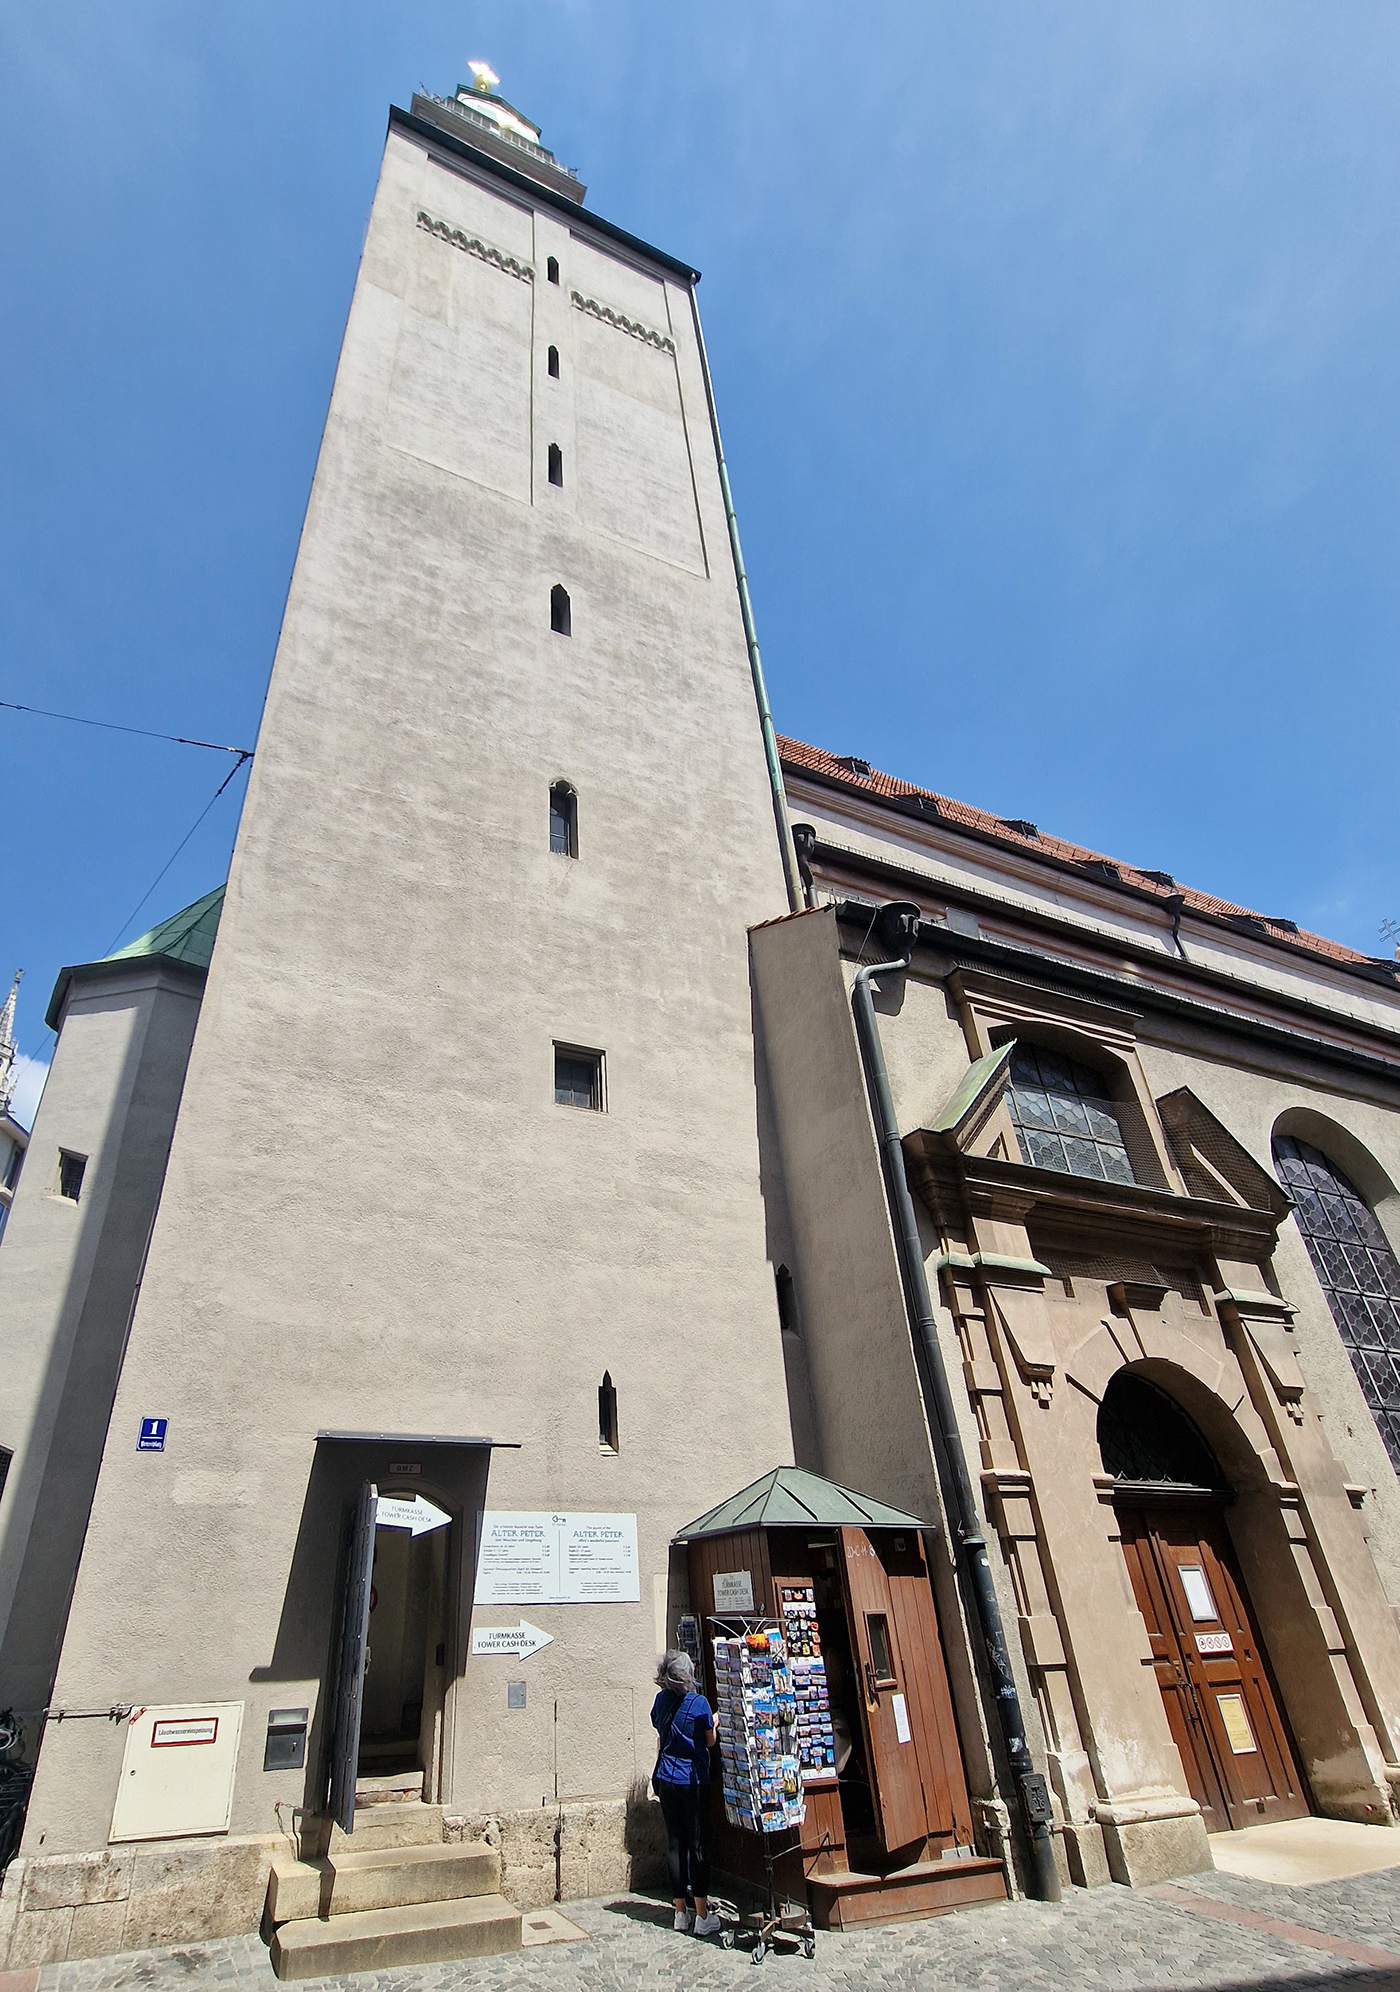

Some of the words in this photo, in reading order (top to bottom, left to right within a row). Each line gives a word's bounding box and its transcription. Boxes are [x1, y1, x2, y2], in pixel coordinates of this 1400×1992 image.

[149, 1420, 159, 1435] 1
[391, 1506, 423, 1515] TURMKASSE
[491, 1529, 518, 1537] ALTER
[520, 1530, 546, 1538] PETER
[488, 1632, 526, 1640] TURMKASSE
[501, 1640, 519, 1648] CASH
